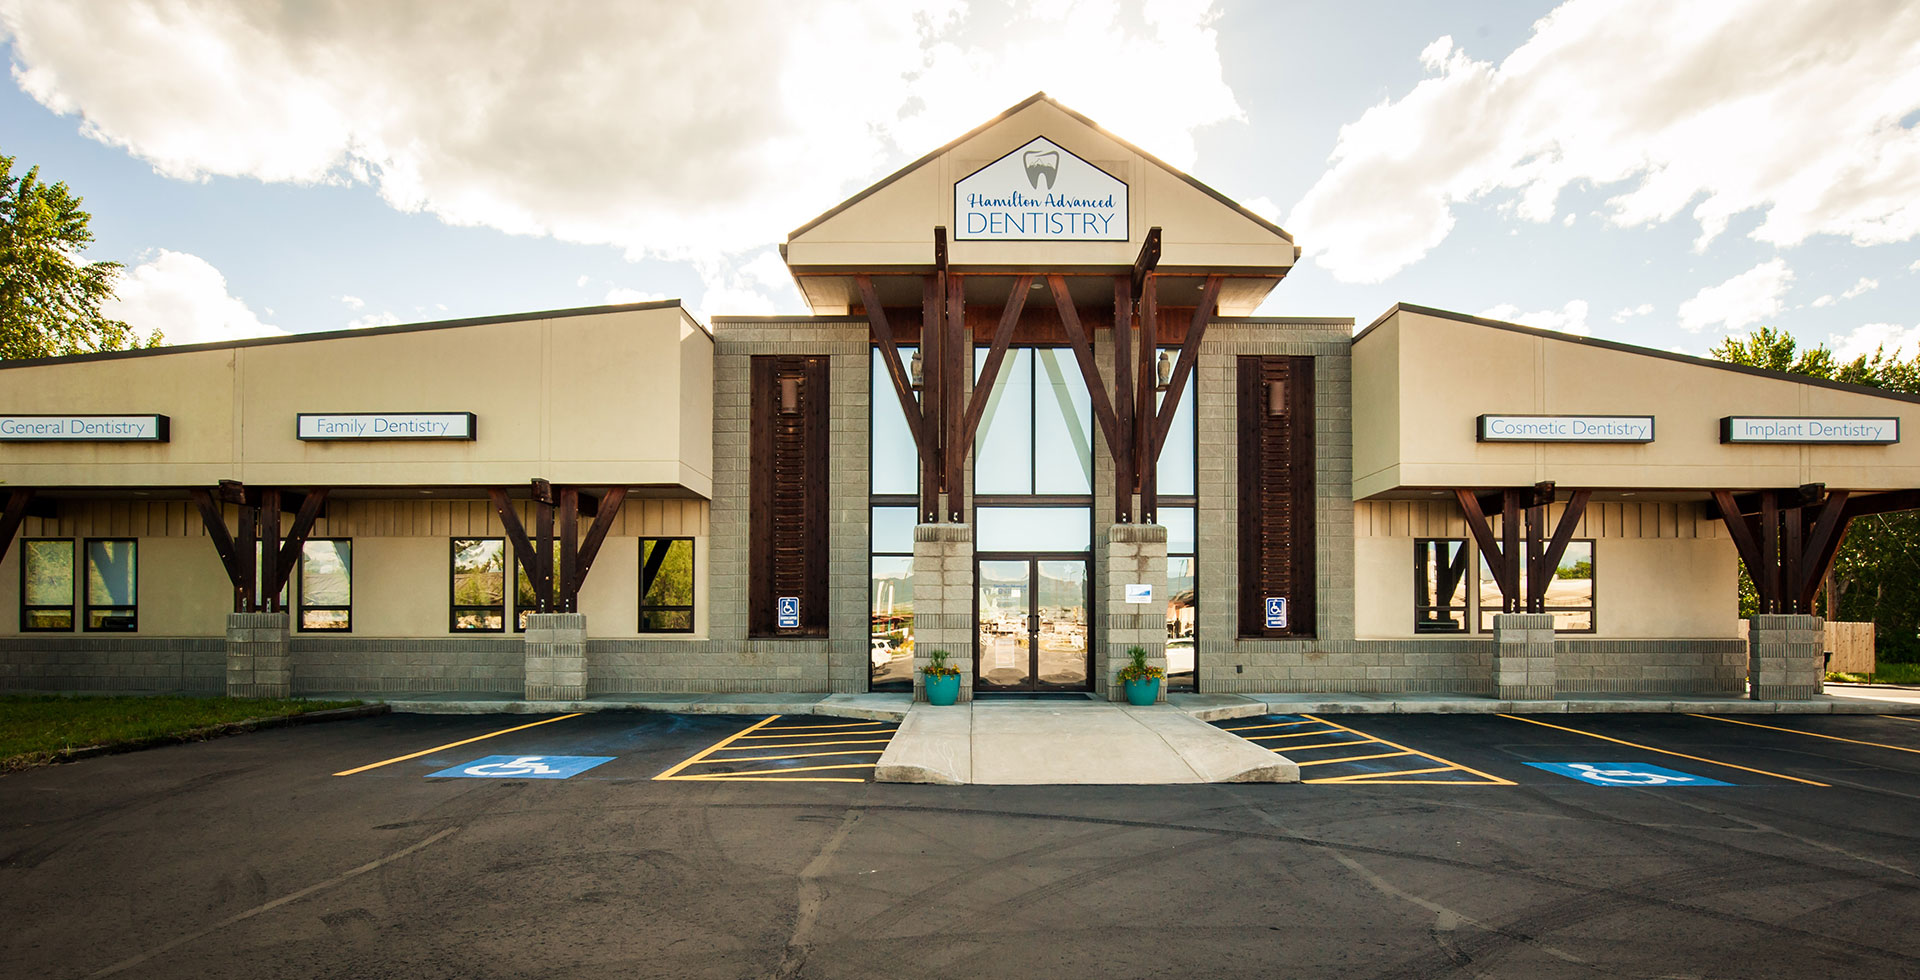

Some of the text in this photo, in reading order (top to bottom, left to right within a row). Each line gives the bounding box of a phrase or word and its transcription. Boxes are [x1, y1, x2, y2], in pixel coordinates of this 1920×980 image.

[966, 190, 1117, 209] Hamilton Advanced
[967, 212, 1115, 234] DENTISTRY
[1, 419, 146, 438] General Dentistry
[317, 418, 450, 437] Family Dentistry
[1491, 419, 1647, 440] Cosmetic Dentistry
[1745, 421, 1883, 441] Implant Dentistry
